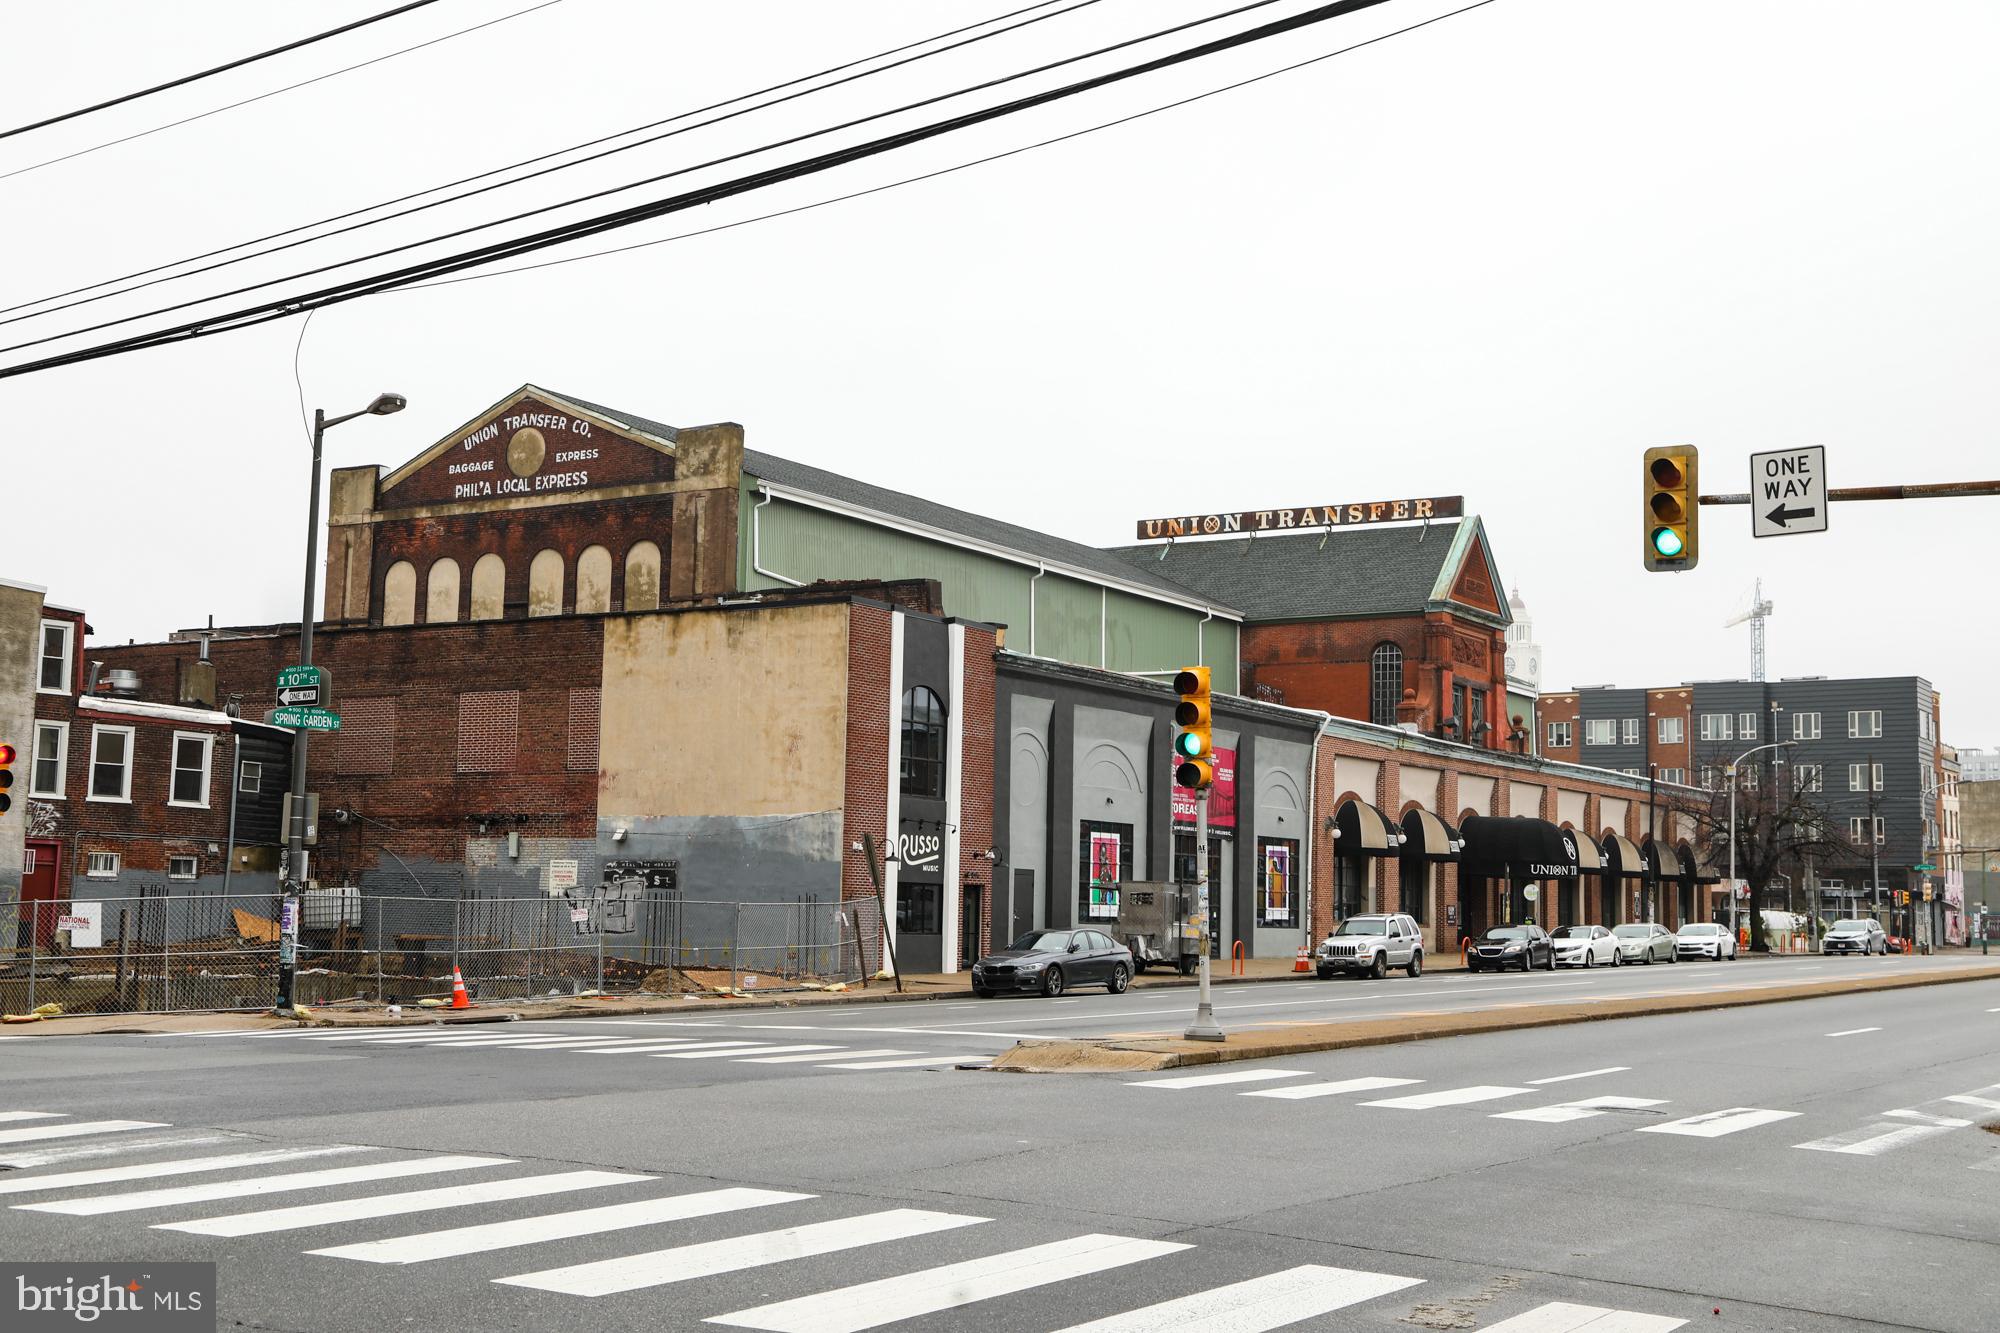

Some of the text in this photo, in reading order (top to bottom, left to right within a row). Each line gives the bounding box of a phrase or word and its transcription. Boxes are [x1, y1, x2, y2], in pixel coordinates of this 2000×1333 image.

[463, 413, 592, 451] UNION TRANSFER CO.
[555, 448, 599, 463] EXPRESS
[448, 460, 494, 475] BAGGAGE
[1765, 455, 1810, 477] ONE
[455, 470, 588, 499] PHIL'A LOCAL EXPRESS
[1764, 477, 1812, 500] WAY
[1145, 498, 1434, 538] UNION TRANSFER
[287, 673, 308, 685] 10TH
[309, 675, 318, 684] ST
[289, 691, 315, 701] ONE WAY
[274, 712, 340, 728] SPRING GARDEN ST
[899, 834, 939, 866] RUSSO
[922, 864, 939, 872] MUSIC
[1530, 864, 1569, 876] UNION
[59, 916, 90, 925] NATIONAL
